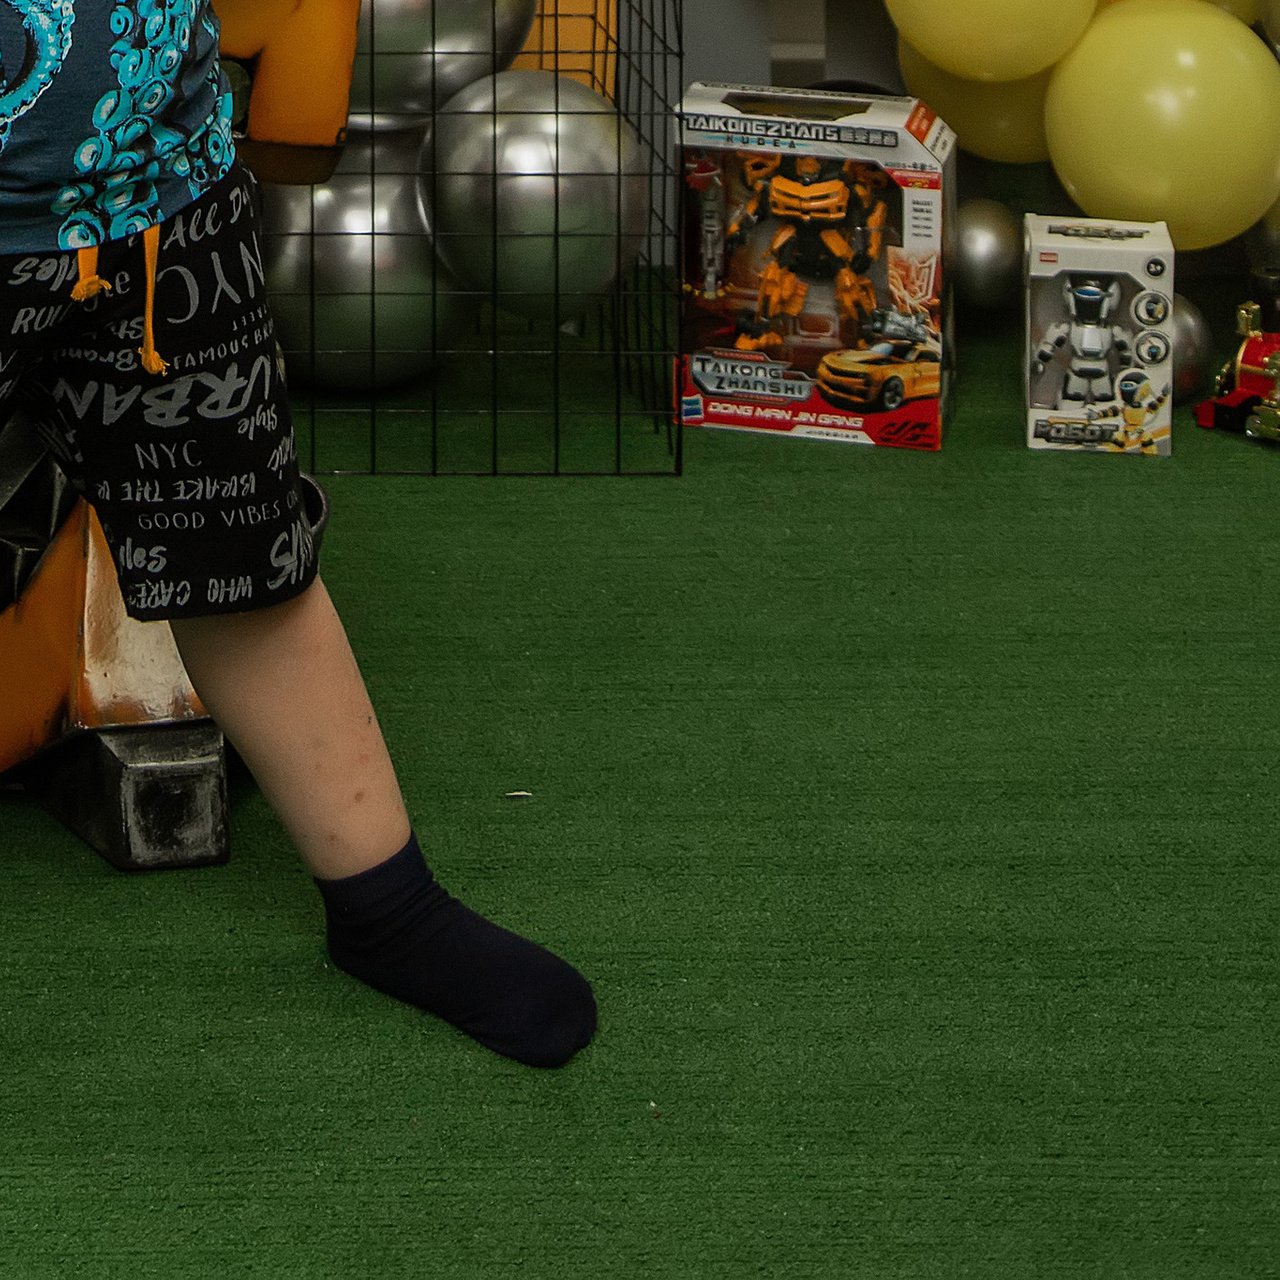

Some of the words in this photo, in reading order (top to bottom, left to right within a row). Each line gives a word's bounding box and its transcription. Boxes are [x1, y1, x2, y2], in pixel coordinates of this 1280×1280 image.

[156, 230, 267, 325] NYC
[174, 333, 249, 370] FAMOUS
[695, 356, 783, 379] TAIKONG
[715, 376, 804, 397] ZHANSHI
[708, 402, 754, 417] DONG
[755, 407, 792, 421] MAN
[792, 411, 816, 424] JIN
[817, 413, 864, 428] GANG
[134, 439, 202, 470] NYC
[121, 478, 164, 503] THE
[172, 470, 257, 502] BRAKE
[138, 511, 205, 530] GOOD
[220, 498, 281, 527] VIBES
[207, 575, 253, 605] WHO
